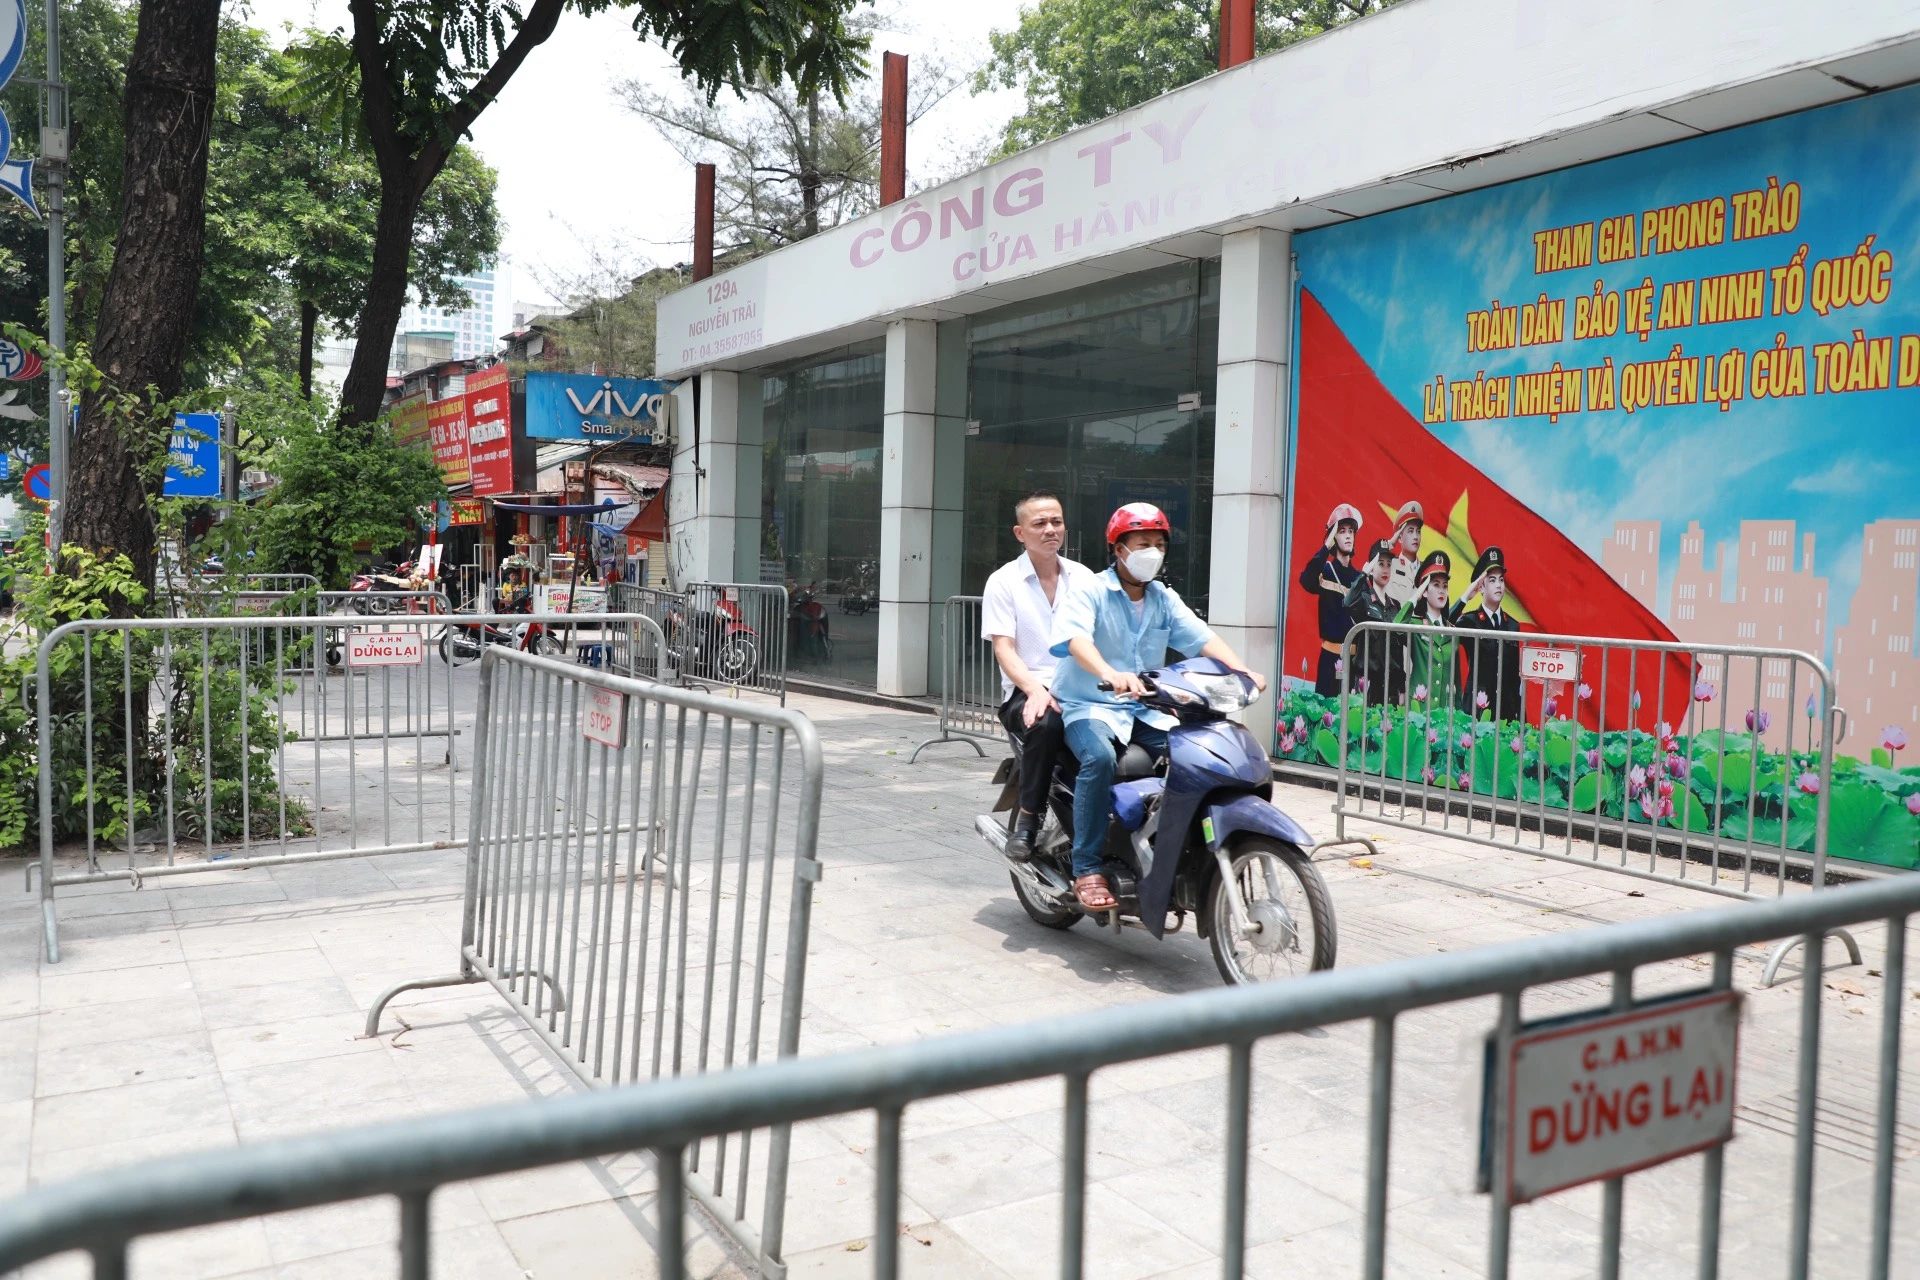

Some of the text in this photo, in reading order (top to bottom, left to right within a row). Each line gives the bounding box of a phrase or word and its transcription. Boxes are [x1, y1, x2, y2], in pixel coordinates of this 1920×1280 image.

[849, 167, 1044, 269] CÔNG
[1534, 176, 1801, 274] THAM GIA PHONG TRÀO
[952, 231, 1038, 281] CỬA
[707, 279, 738, 305] 129A
[1467, 234, 1893, 353] TOÀN DÂN BẢO VỆ AN NINH TỔ QUỐC
[688, 299, 756, 338] NGUYỄN TRÃI
[699, 327, 763, 359] 04.35587955
[1423, 329, 1920, 424] LÀ TRÁCH NHIỆM VÀ QUYỀN LỢI CỦA TOÀN D
[354, 644, 417, 658] DỪNG LẠI
[1532, 661, 1564, 673] STOP
[1537, 651, 1560, 659] POLICE
[590, 711, 612, 732] STOP
[1582, 1024, 1684, 1071] C.A.H.N
[1528, 1066, 1725, 1156] DỪNG LẠI
